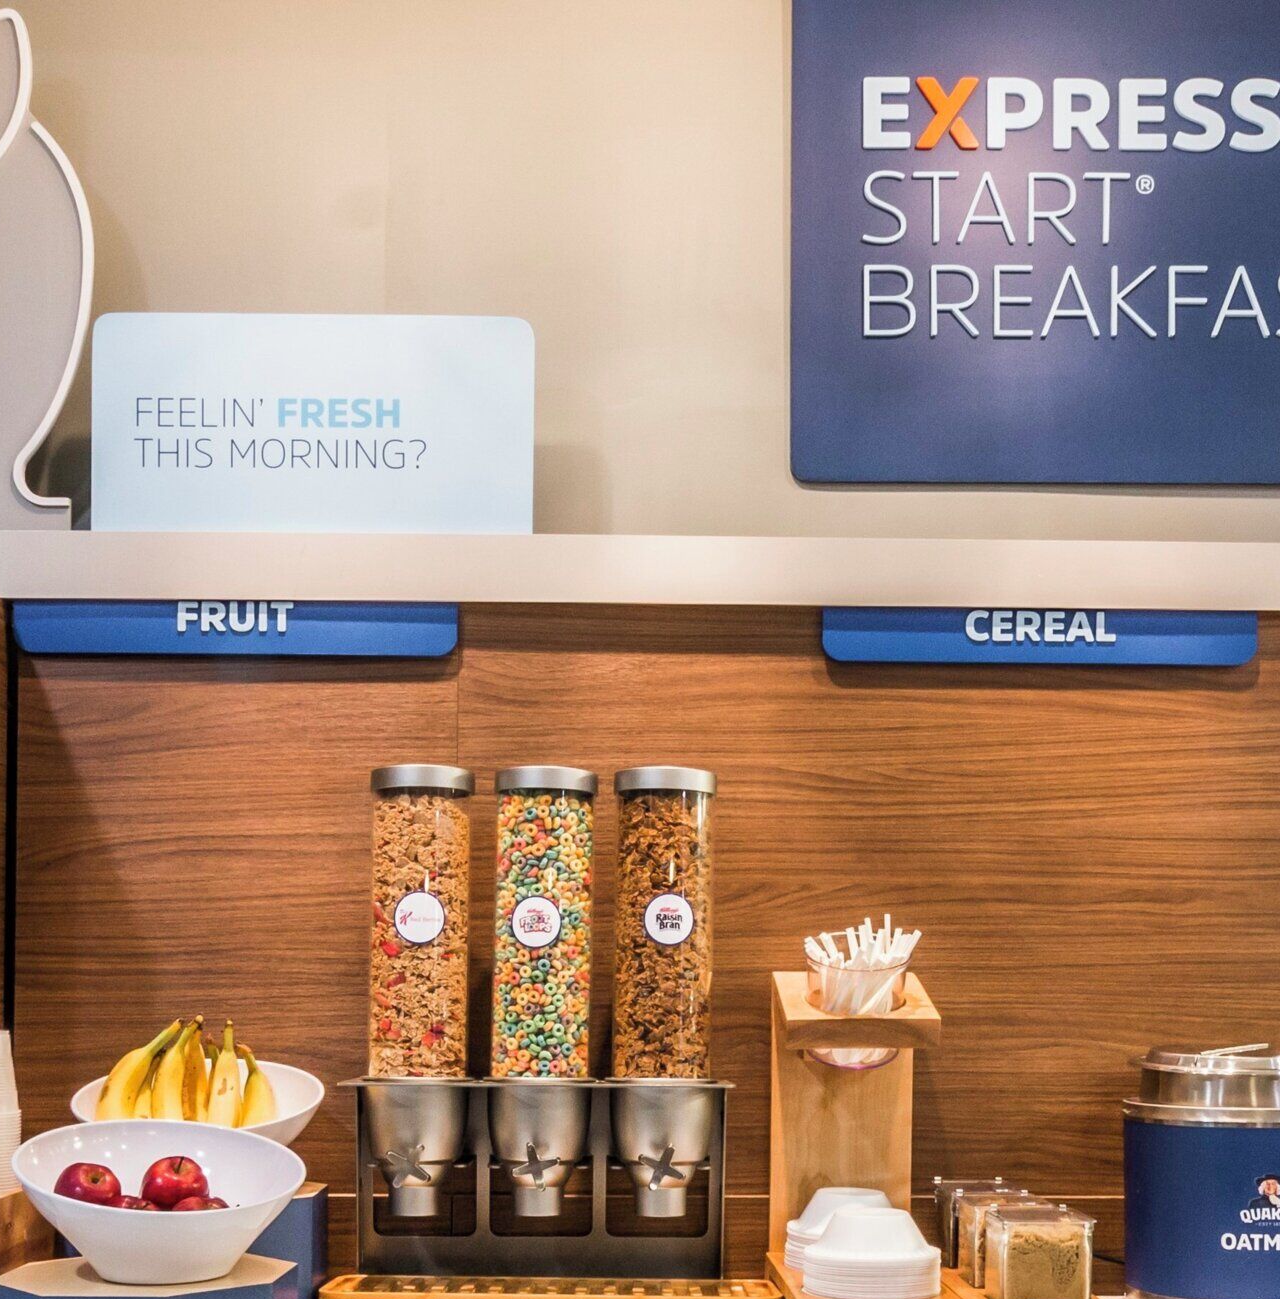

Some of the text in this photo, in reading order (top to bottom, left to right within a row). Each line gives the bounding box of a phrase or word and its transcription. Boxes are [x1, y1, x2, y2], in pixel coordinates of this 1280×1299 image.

[277, 397, 401, 429] FRESH
[133, 437, 427, 470] THIS MORNING?
[176, 601, 295, 633] FRUIT
[965, 609, 1117, 642] CEREAL
[655, 913, 683, 922] Raisin
[659, 921, 680, 930] Bran
